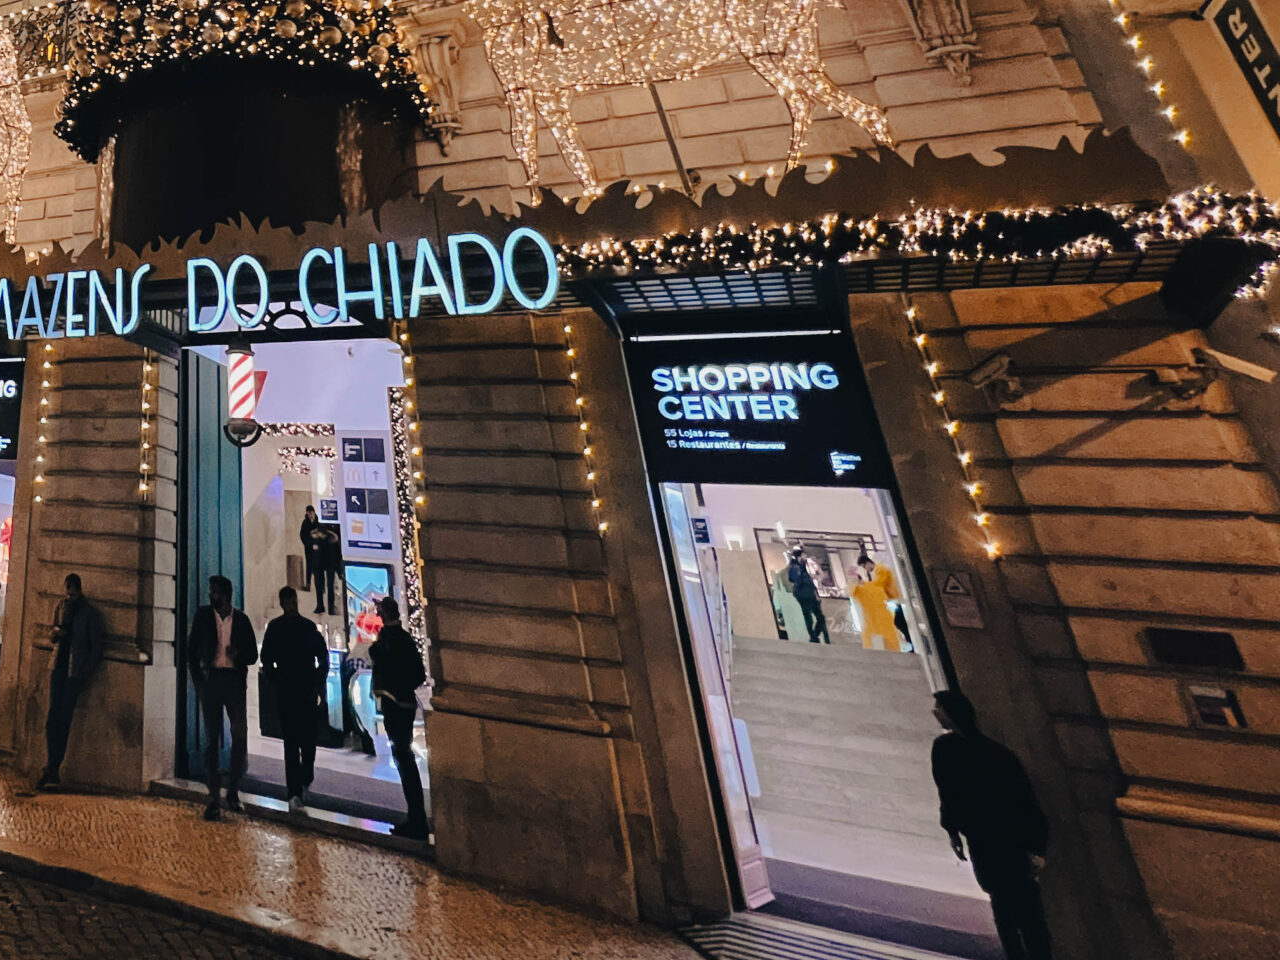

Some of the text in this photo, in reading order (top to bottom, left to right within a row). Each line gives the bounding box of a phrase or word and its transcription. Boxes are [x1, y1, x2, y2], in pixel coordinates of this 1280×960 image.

[186, 253, 269, 332] DO
[299, 227, 560, 325] CHIADO
[651, 363, 840, 392] SHOPPING
[658, 394, 800, 420] CENTER
[664, 429, 677, 437] 55
[678, 429, 704, 439] Lojas
[667, 440, 678, 449] 15
[679, 440, 741, 450] Restaurantes
